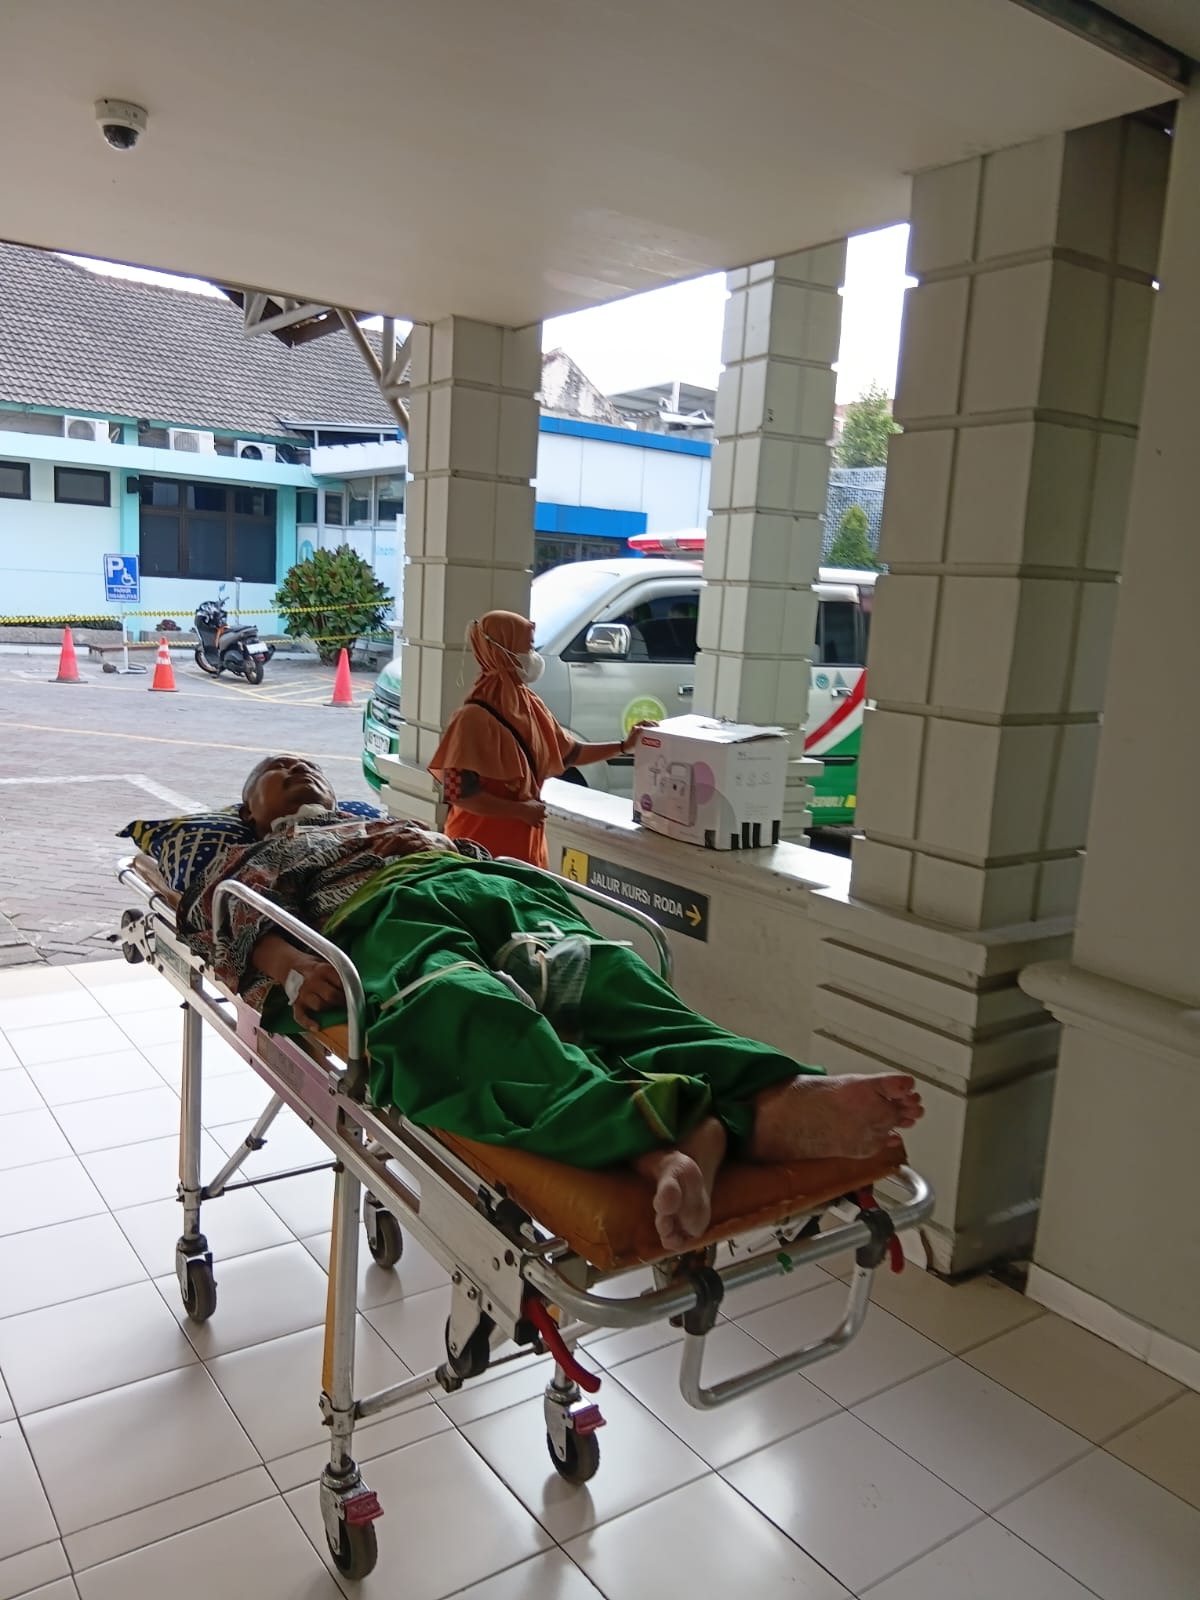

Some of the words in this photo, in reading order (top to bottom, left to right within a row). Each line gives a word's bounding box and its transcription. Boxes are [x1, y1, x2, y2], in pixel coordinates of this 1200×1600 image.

[107, 557, 124, 578] P
[590, 871, 620, 895] JALUR
[621, 882, 651, 906] KURSI
[653, 893, 684, 919] RODA
